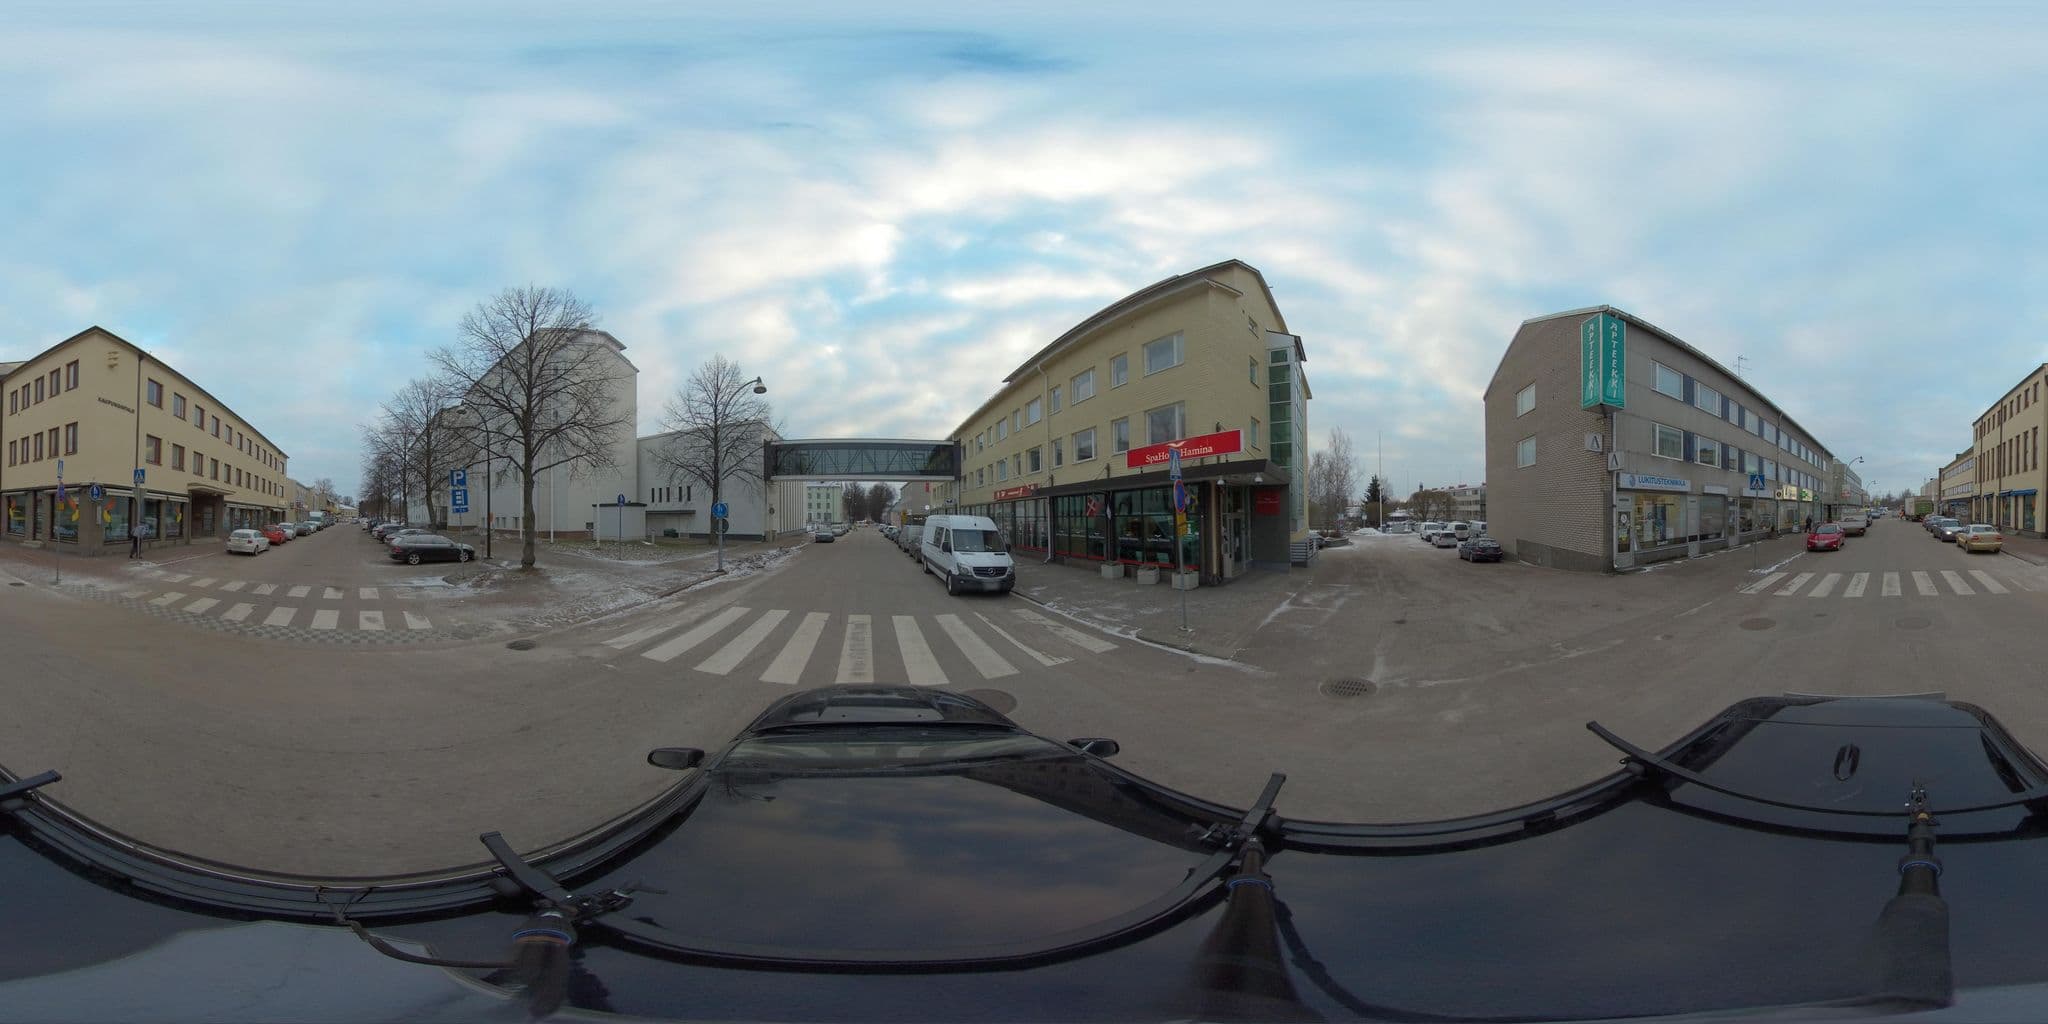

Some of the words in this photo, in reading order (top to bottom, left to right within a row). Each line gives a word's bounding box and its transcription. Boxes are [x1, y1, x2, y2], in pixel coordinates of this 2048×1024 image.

[1587, 323, 1595, 400] APTEEKKI
[1610, 322, 1618, 398] APTEEKKI
[453, 471, 464, 485] P
[1145, 451, 1170, 464] SpaHo
[1180, 445, 1213, 457] Hamina
